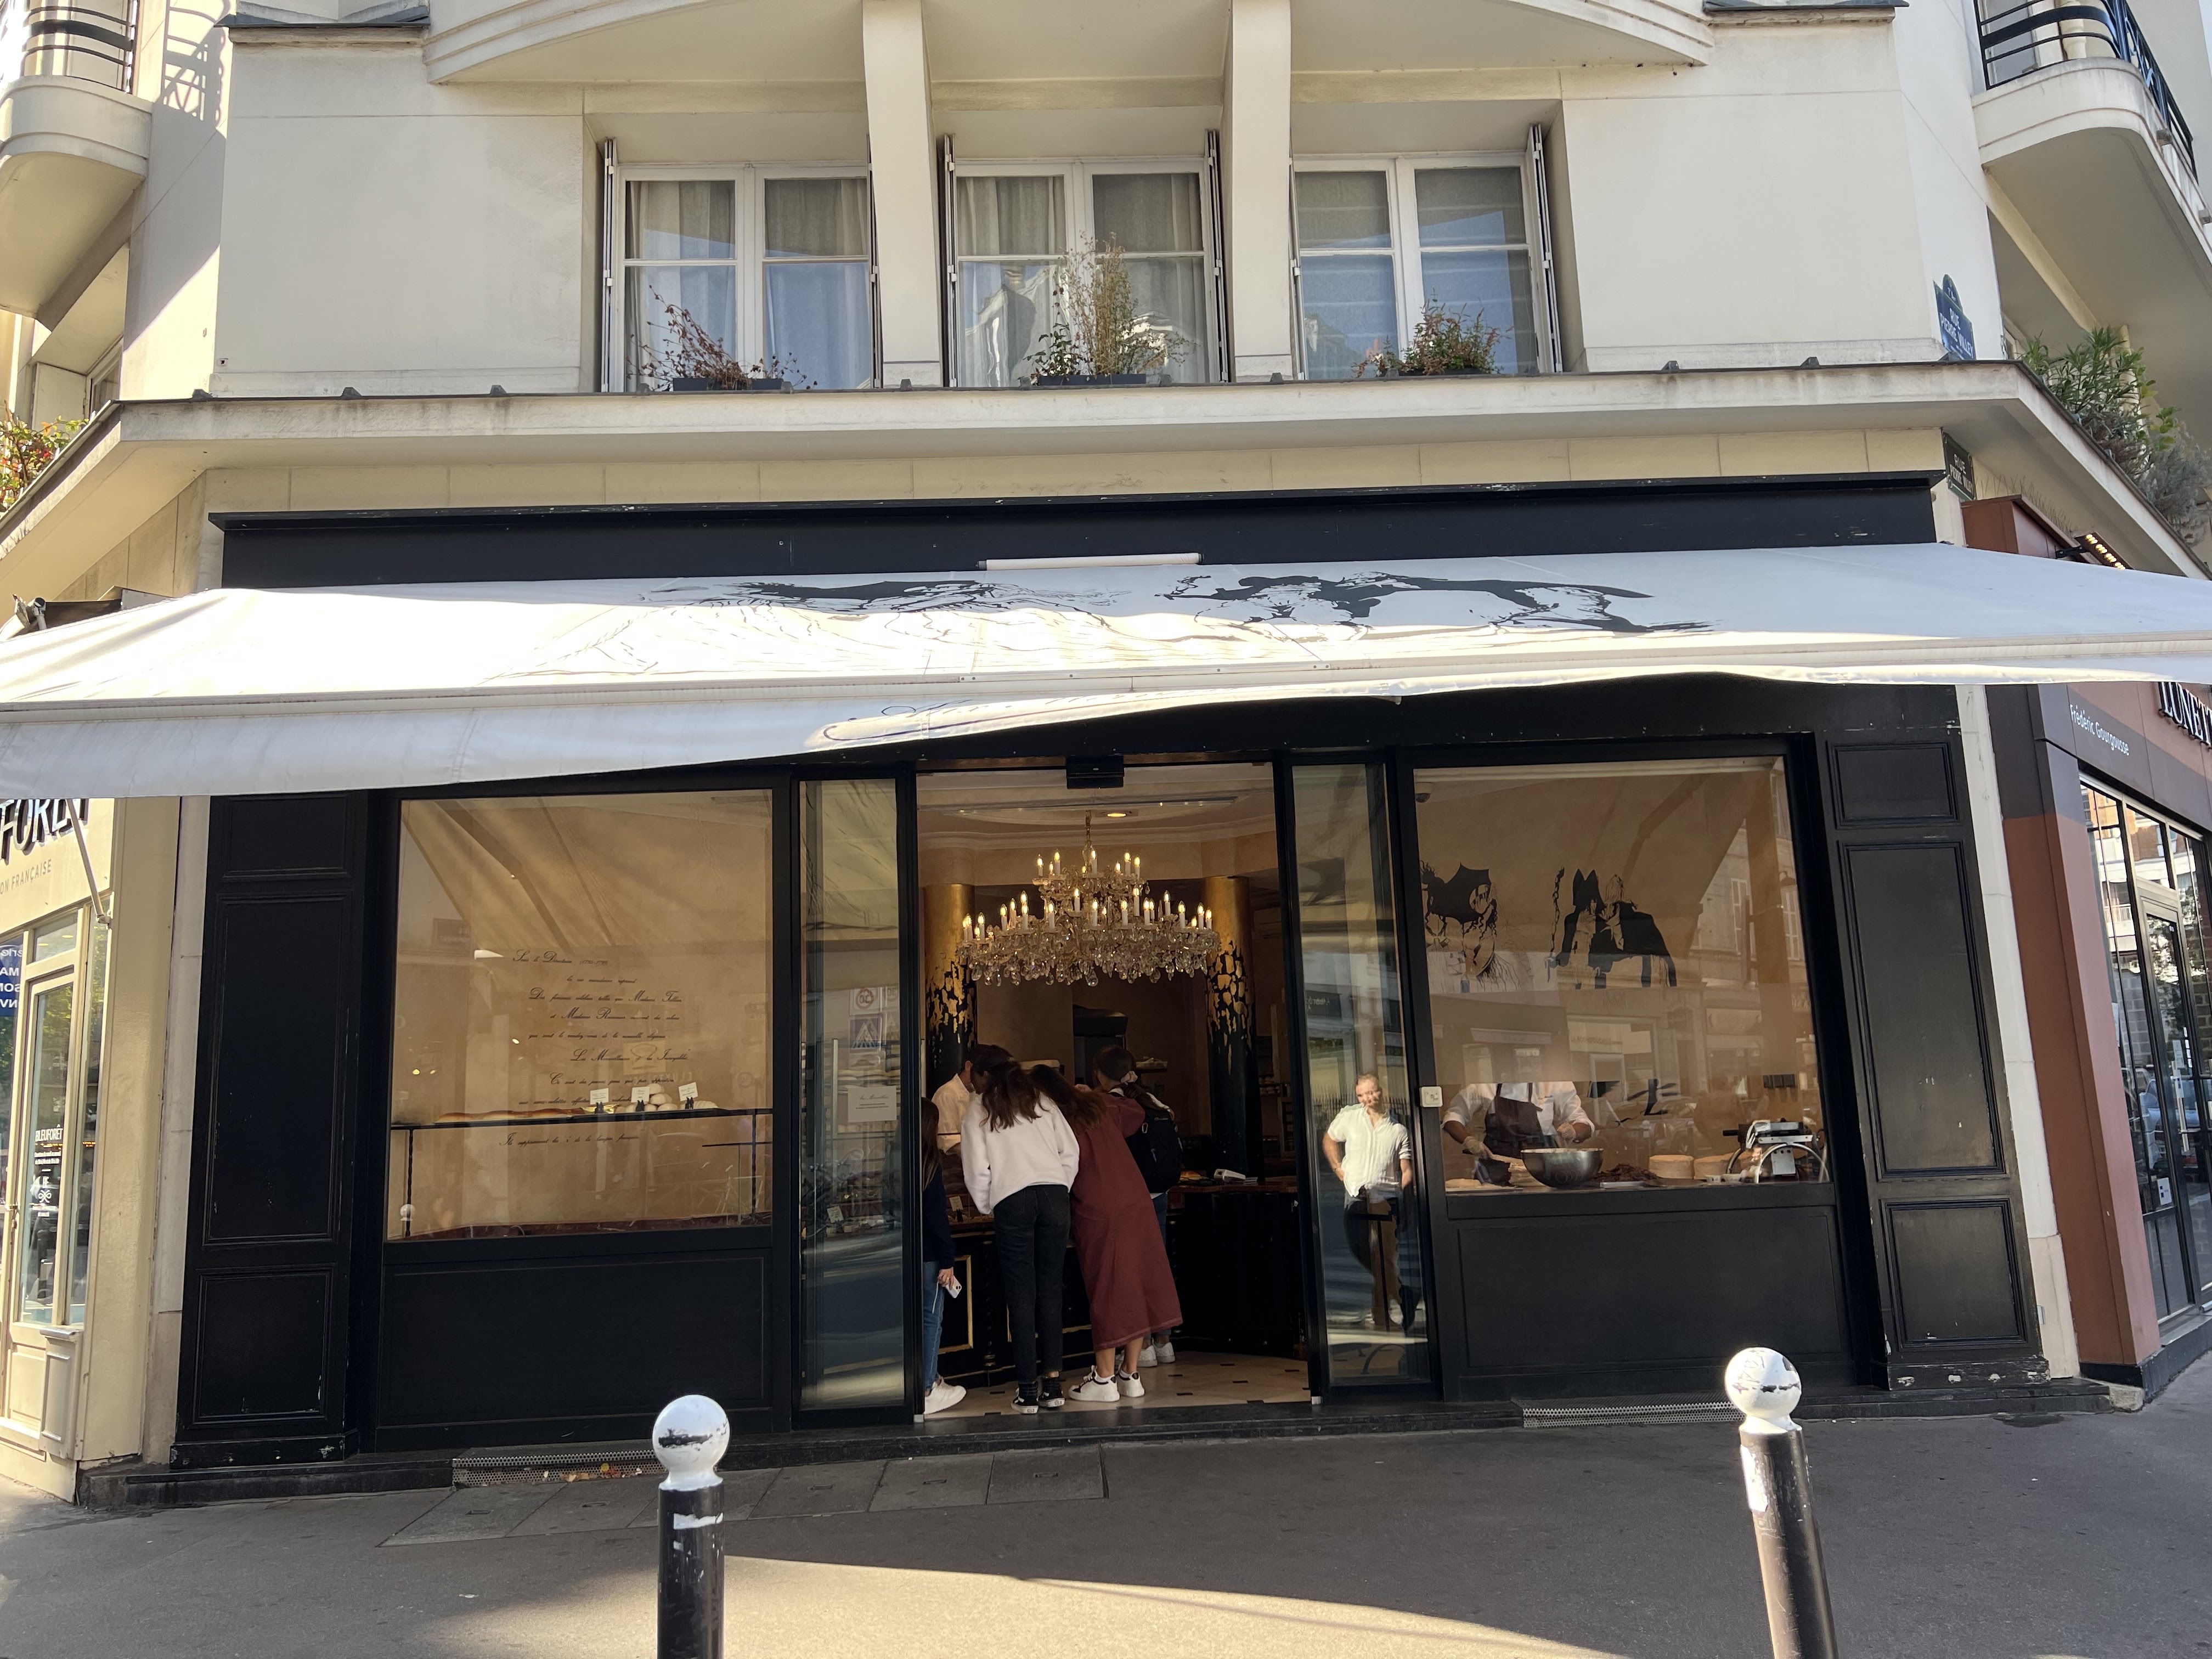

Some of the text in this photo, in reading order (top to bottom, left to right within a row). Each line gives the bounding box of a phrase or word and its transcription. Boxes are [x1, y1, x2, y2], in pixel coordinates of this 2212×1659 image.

[1949, 307, 1961, 331] RUE
[1954, 453, 1967, 475] RUE
[11, 858, 52, 890] FRANÇAISE
[35, 1124, 64, 1142] BLEUFORÊT
